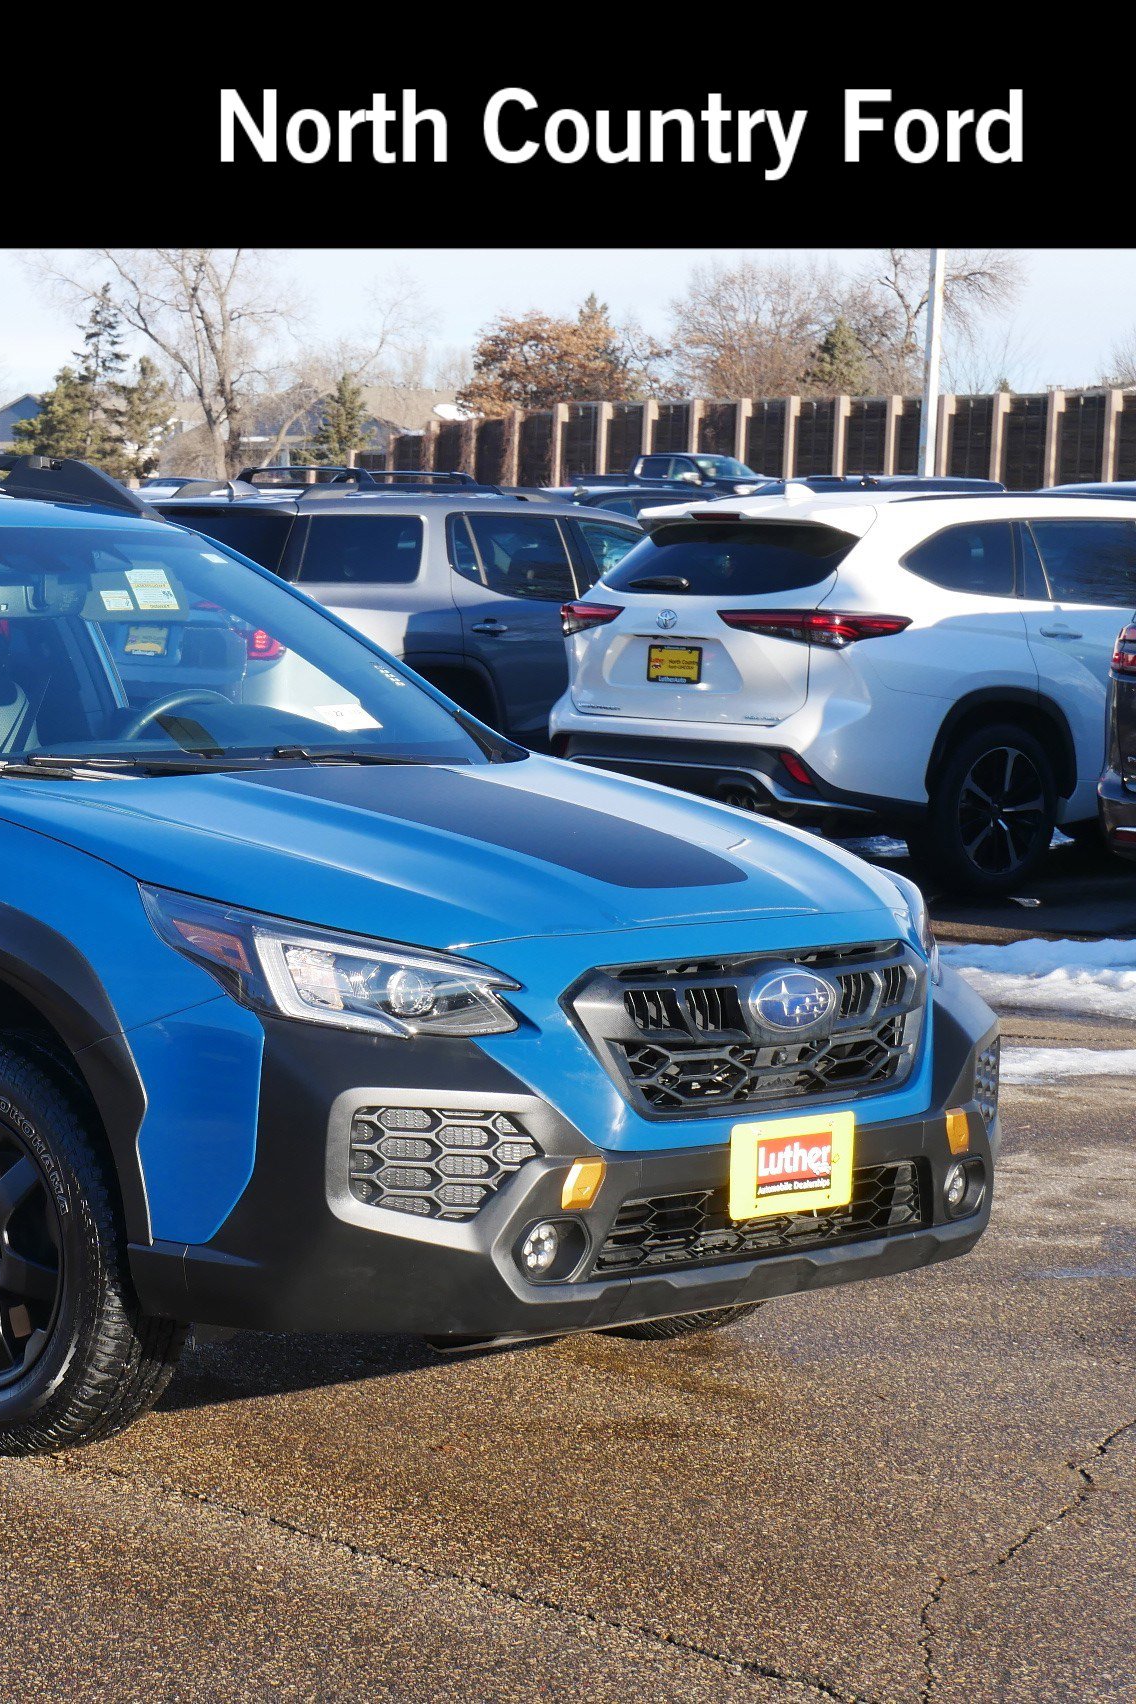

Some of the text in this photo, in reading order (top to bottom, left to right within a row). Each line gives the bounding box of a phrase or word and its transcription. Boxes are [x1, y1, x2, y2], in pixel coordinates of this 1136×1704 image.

[757, 1141, 832, 1177] Luther
[757, 1177, 831, 1196] Automobile Dealerships
